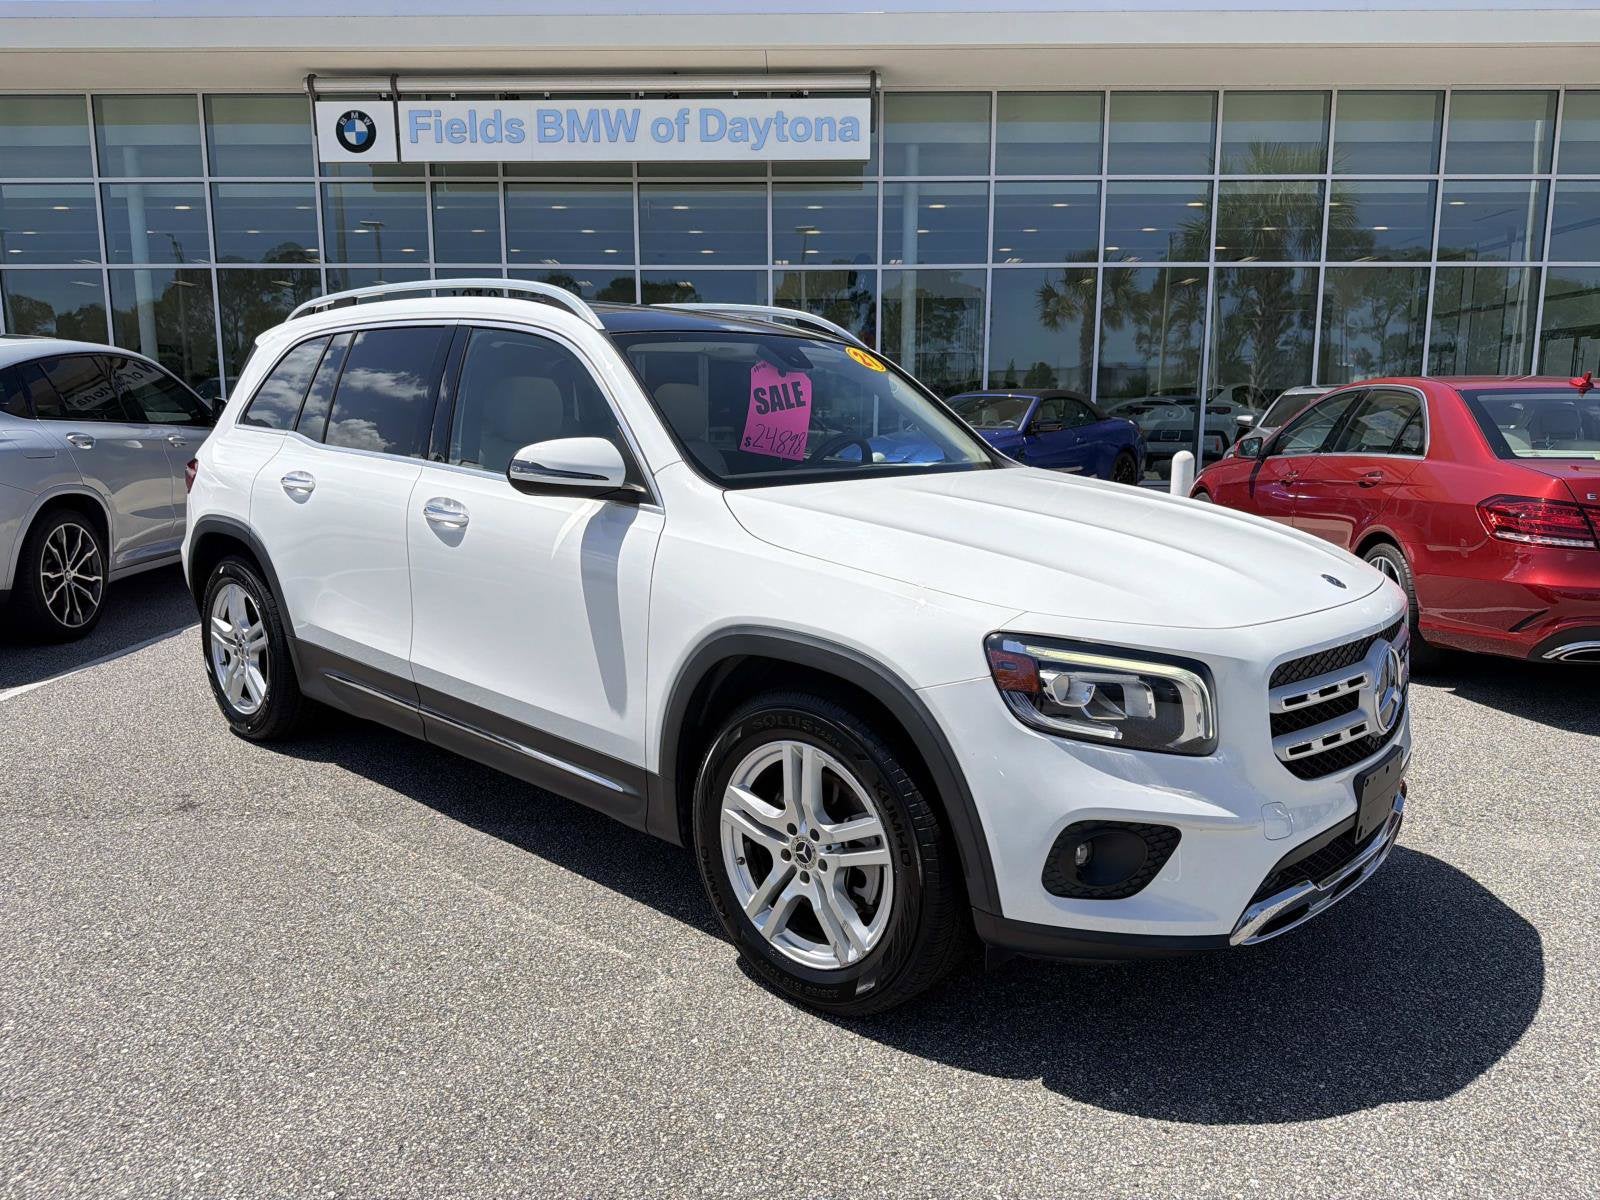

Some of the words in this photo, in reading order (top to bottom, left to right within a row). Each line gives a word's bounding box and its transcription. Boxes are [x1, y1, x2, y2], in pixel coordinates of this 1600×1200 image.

[339, 111, 372, 126] BMW
[408, 109, 526, 144] Fields
[536, 108, 640, 143] BMW
[650, 108, 689, 143] of
[699, 108, 860, 150] Daytona
[753, 381, 806, 415] SALE
[873, 784, 912, 868] KUMHO
